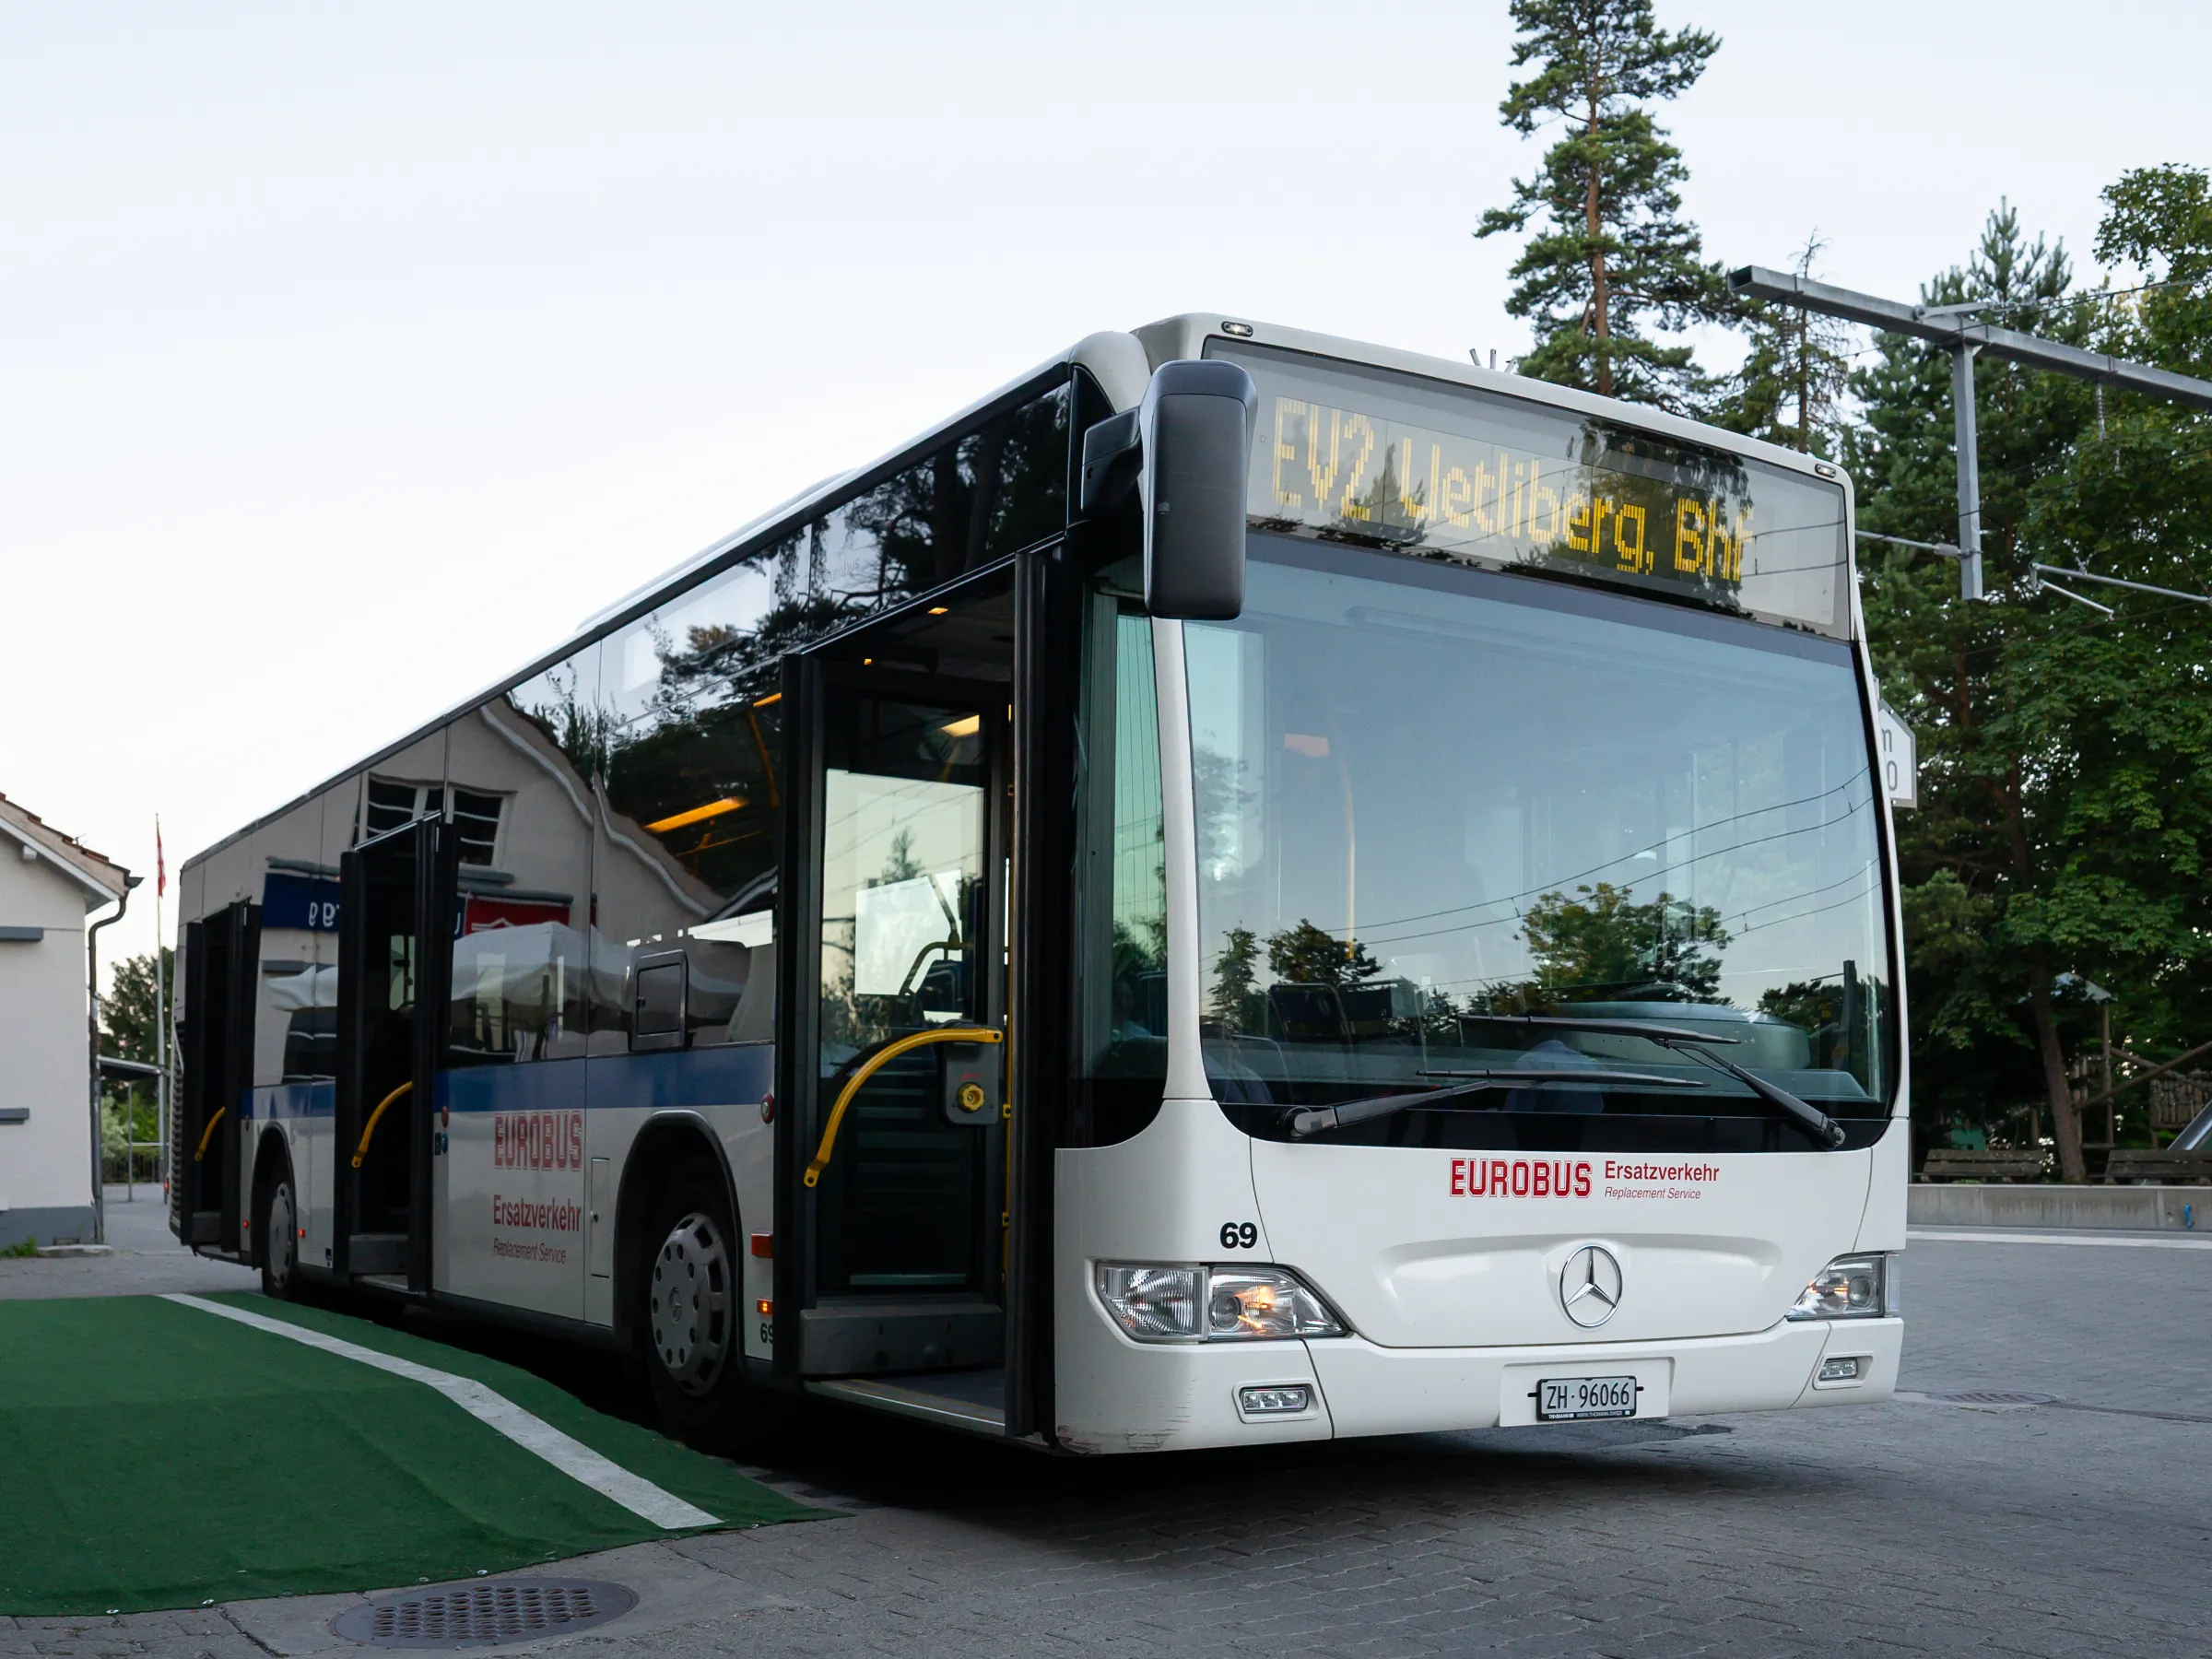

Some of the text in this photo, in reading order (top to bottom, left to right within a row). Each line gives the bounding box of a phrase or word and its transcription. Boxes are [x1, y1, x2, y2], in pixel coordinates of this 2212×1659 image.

[1275, 396, 1374, 522] EV2
[493, 1110, 582, 1171] EUROBUS
[1449, 1158, 1594, 1199] EUROBUS
[1604, 1160, 1721, 1182] Ersatzverkehr
[1604, 1186, 1701, 1200] Replacement Service
[493, 1194, 582, 1232] Ersatzverkehr
[493, 1237, 568, 1265] Replacement Service
[1219, 1221, 1258, 1250] 69
